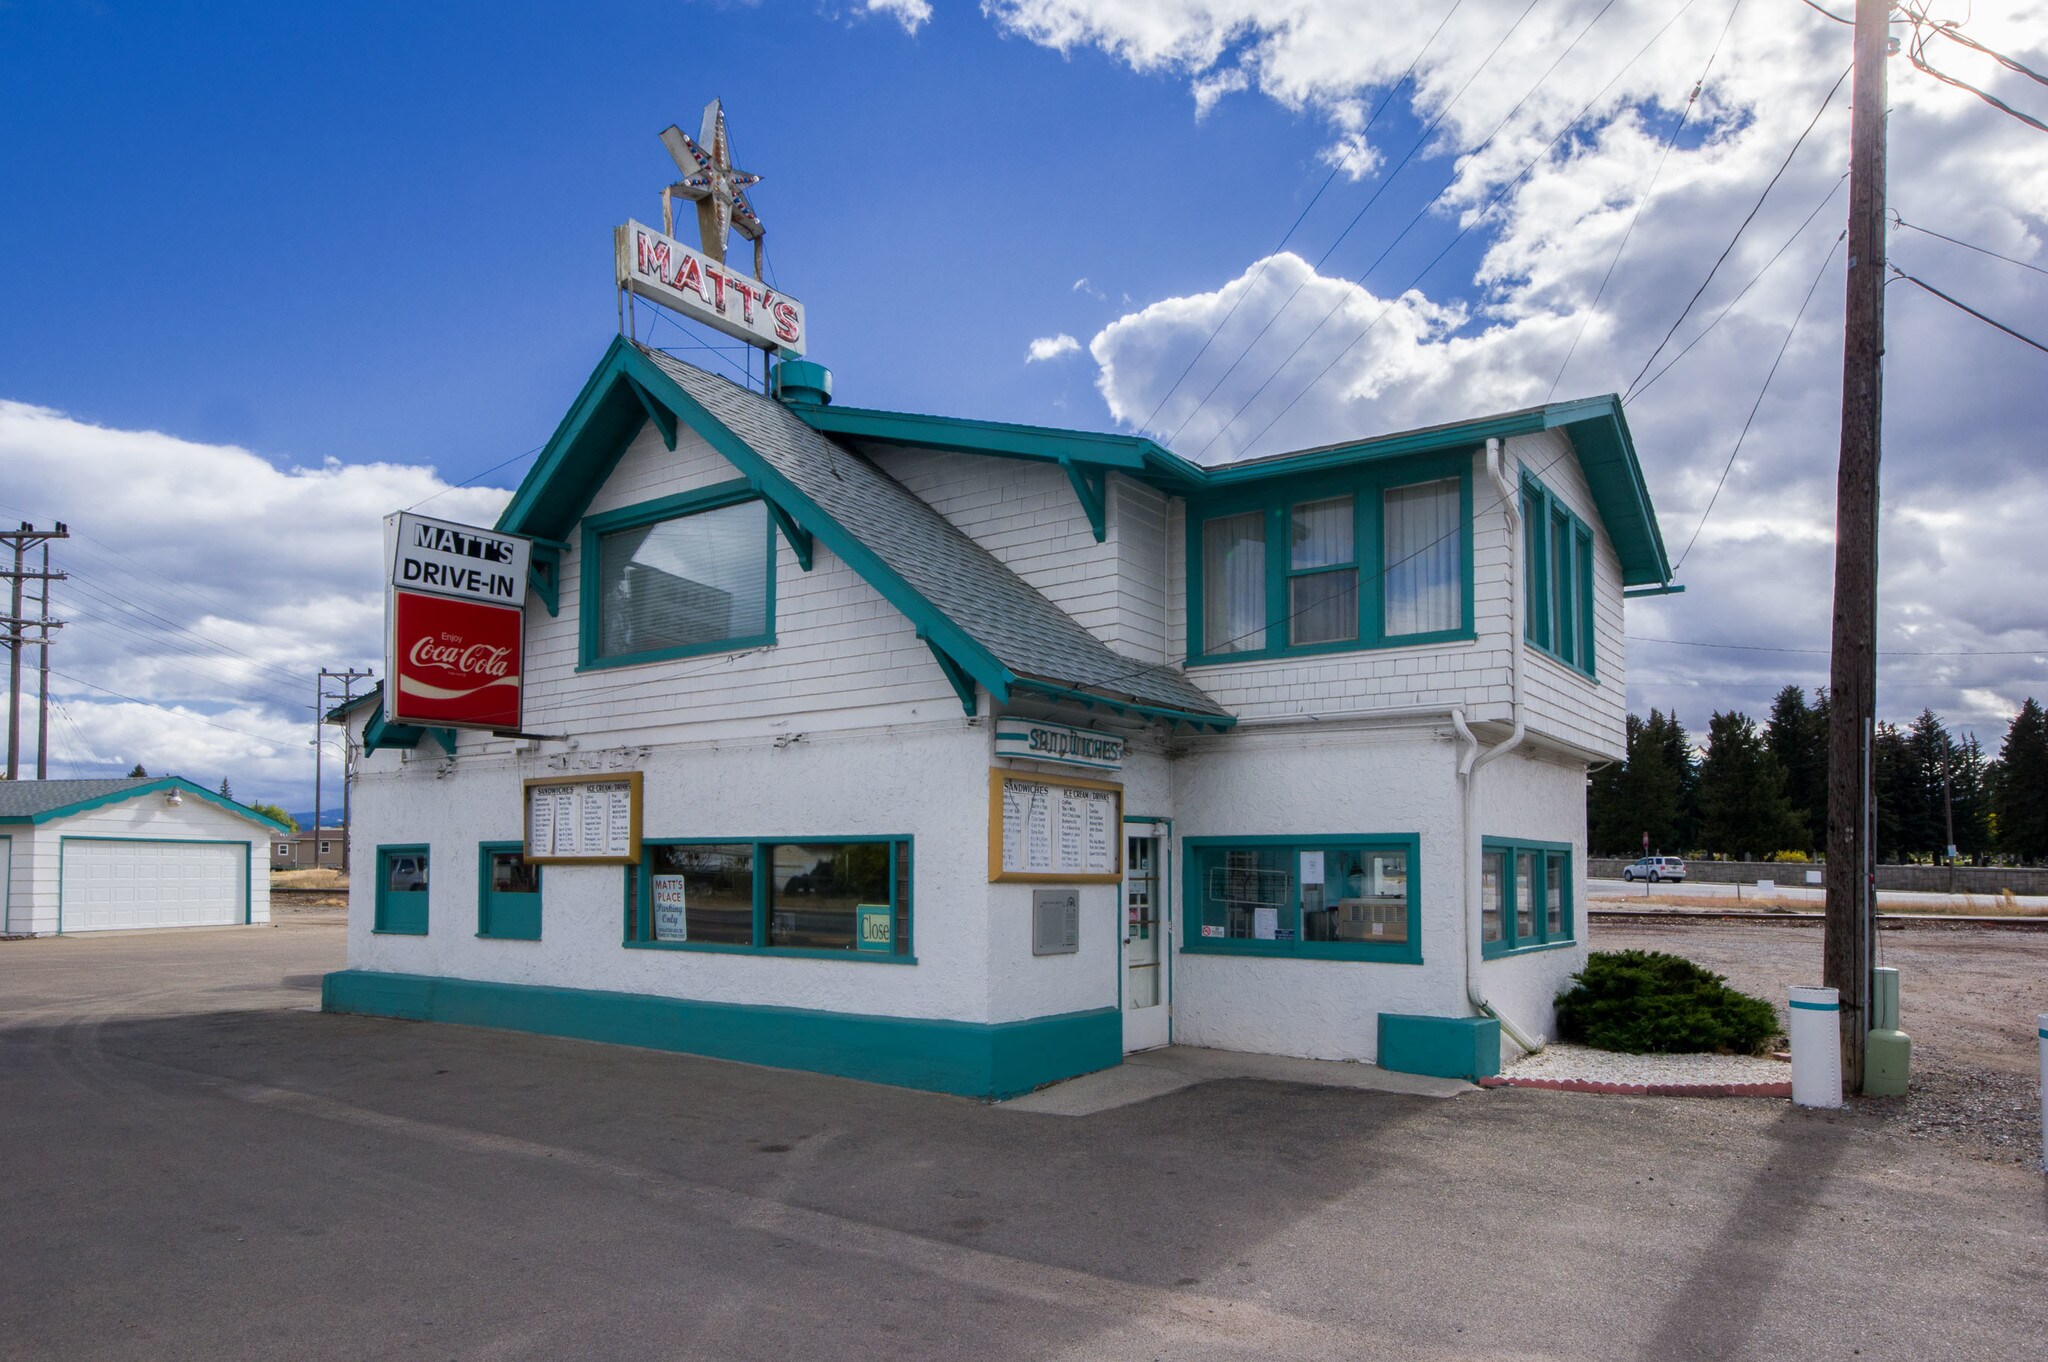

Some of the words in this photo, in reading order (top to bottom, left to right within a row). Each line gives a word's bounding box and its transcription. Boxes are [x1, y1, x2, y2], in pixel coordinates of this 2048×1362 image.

[637, 231, 801, 343] MATT'S
[413, 523, 514, 565] MATT'S
[404, 558, 514, 597] DRIVE-IN
[441, 632, 463, 643] Enjoy
[409, 636, 512, 676] Coca-Cola
[1029, 728, 1122, 761] SANDWICHES
[537, 785, 575, 795] SANDWICHES
[586, 784, 595, 793] ICE
[1004, 782, 1049, 794] SANDWICHES
[1063, 788, 1073, 797] ICE
[1073, 789, 1089, 798] CREAM
[655, 880, 683, 890] MATT'S
[657, 892, 681, 902] PLACE
[656, 903, 683, 916] Parking
[661, 914, 678, 926] Only
